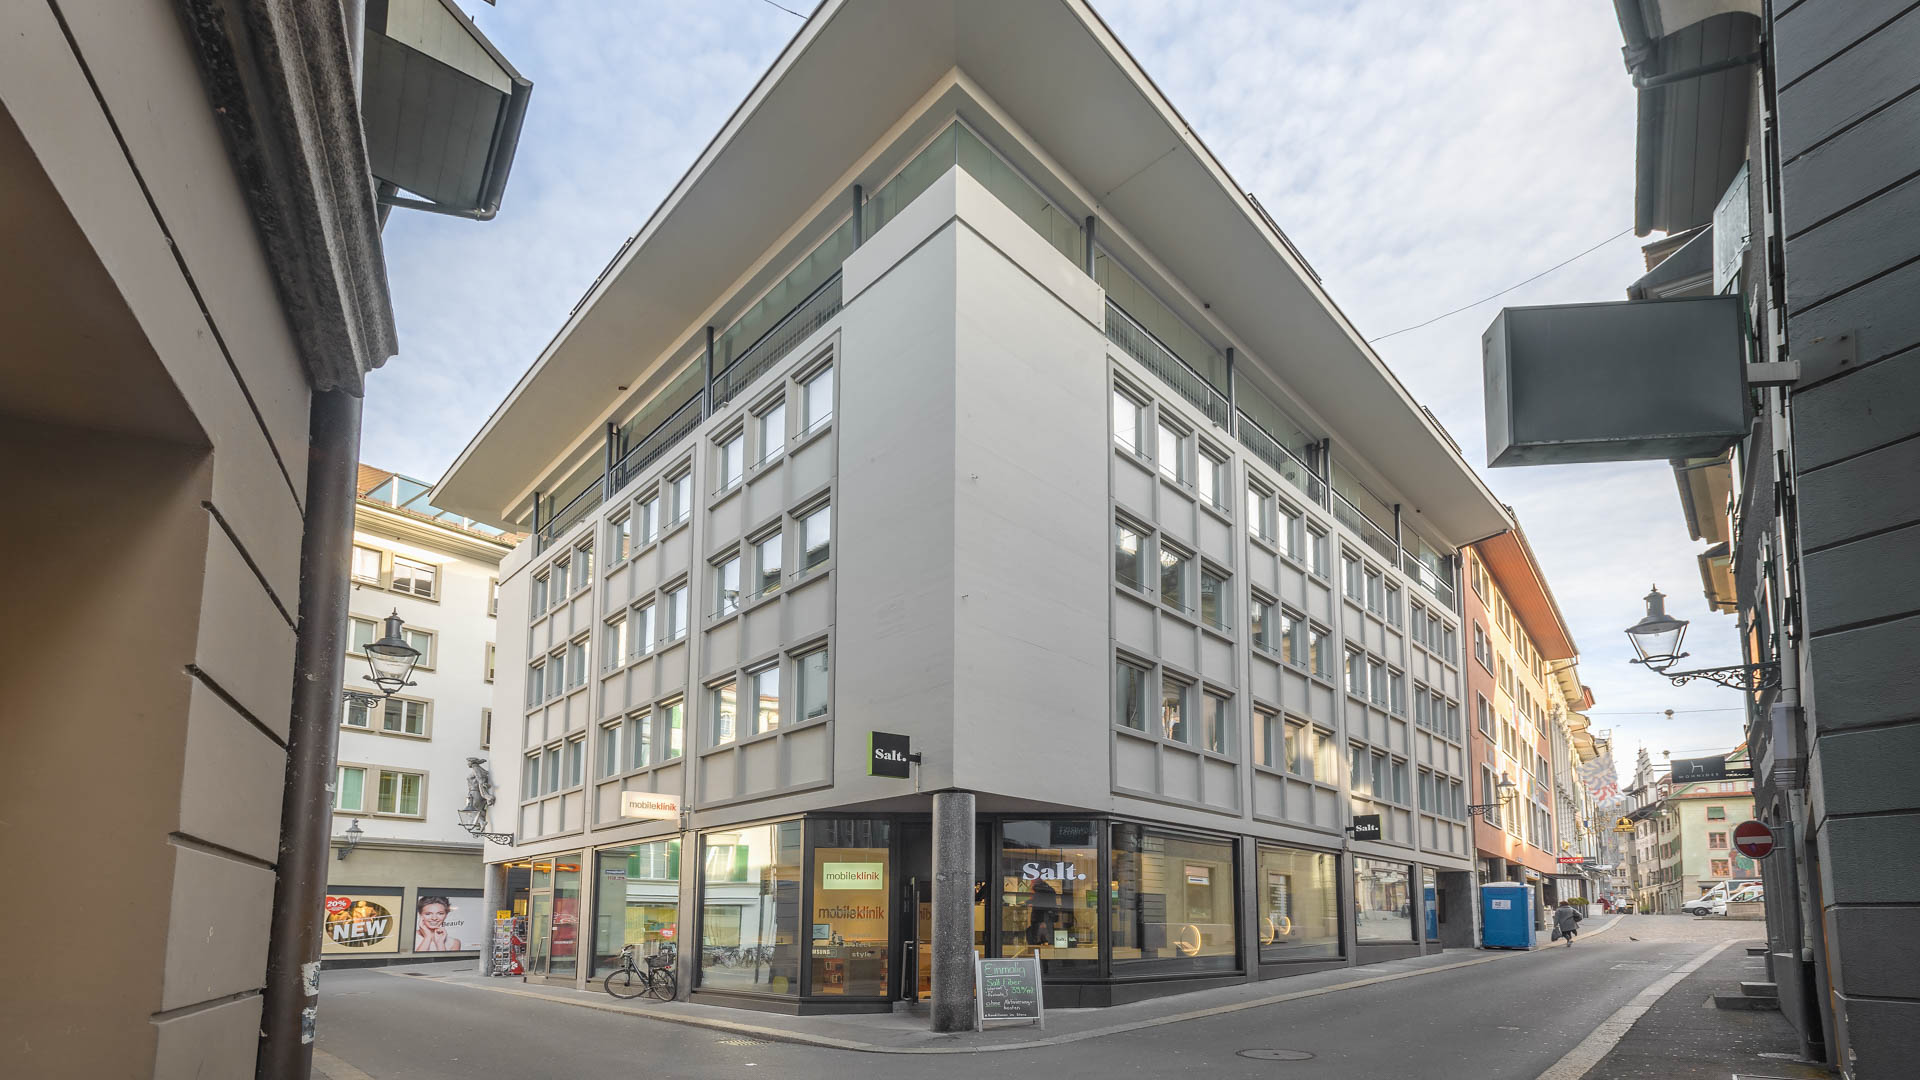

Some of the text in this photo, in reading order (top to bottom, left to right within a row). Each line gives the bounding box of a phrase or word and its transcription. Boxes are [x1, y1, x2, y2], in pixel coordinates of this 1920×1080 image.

[875, 748, 907, 762] Salt.
[629, 801, 677, 812] mobileklinik
[1355, 824, 1379, 832] Salt.
[826, 871, 880, 881] mobileklinik
[1022, 861, 1087, 881] Salt.
[327, 900, 347, 908] 20%
[818, 905, 885, 920] mobileklinik
[333, 918, 388, 940] NEW
[441, 919, 465, 928] Beauty
